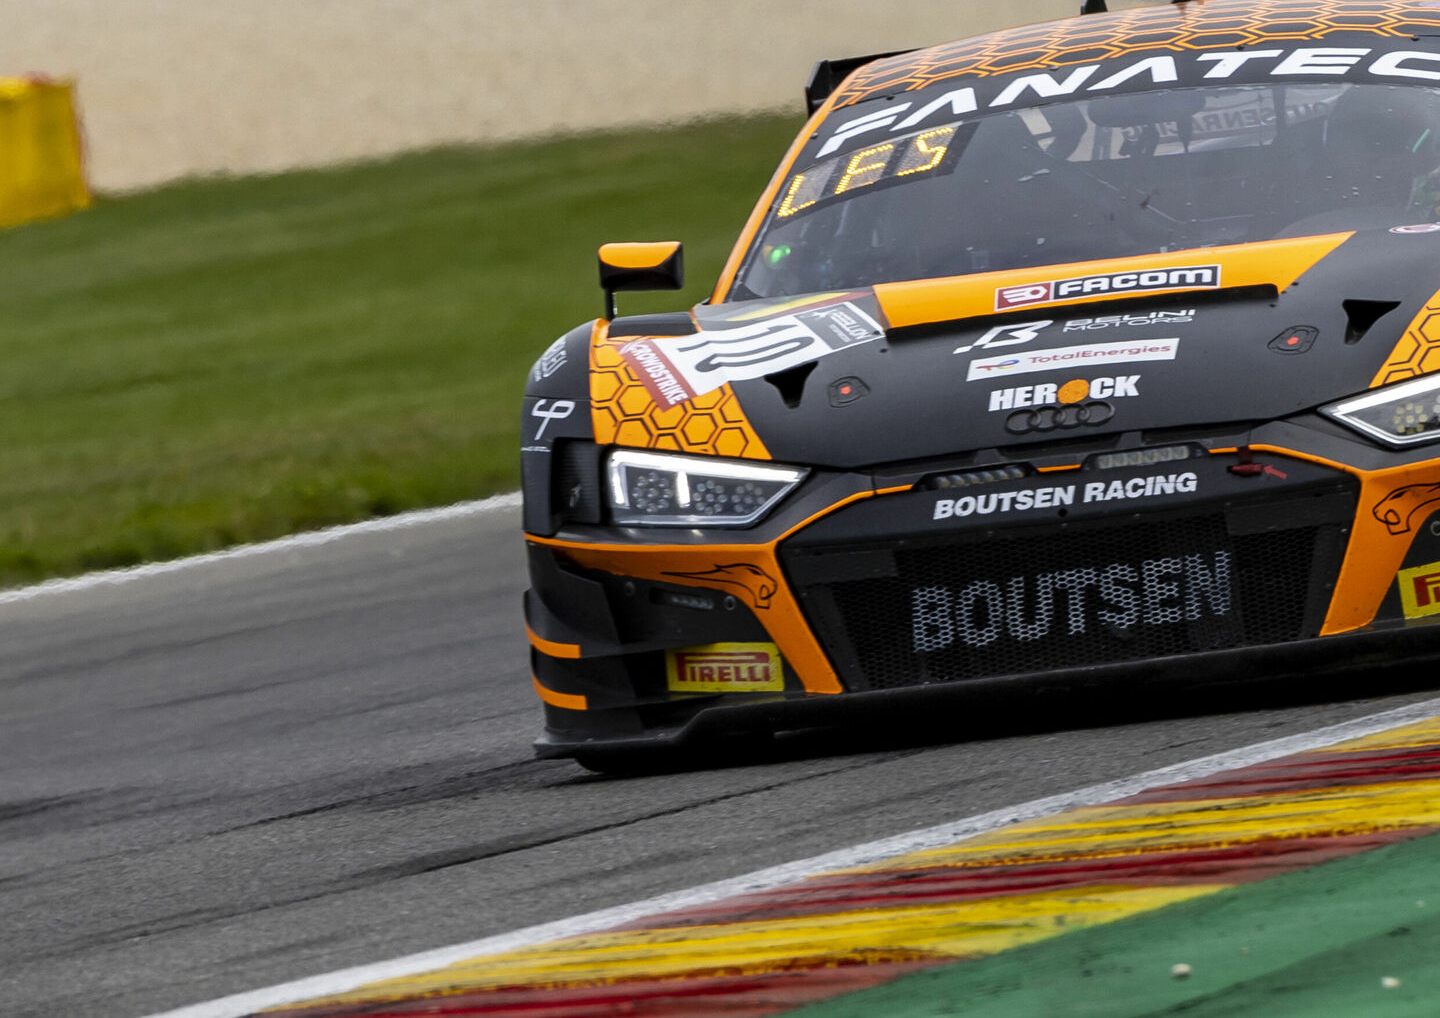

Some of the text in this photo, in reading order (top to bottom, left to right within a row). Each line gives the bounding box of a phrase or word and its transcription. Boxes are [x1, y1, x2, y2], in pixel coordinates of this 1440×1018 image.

[1059, 268, 1213, 297] FACOM
[1028, 344, 1171, 364] TotalEnergies
[630, 342, 689, 406] CROWDSTRIKE
[933, 472, 1199, 520] BOUTSEN RACING
[912, 551, 1232, 652] BOUTSEN
[676, 652, 770, 682] PIRELLI
